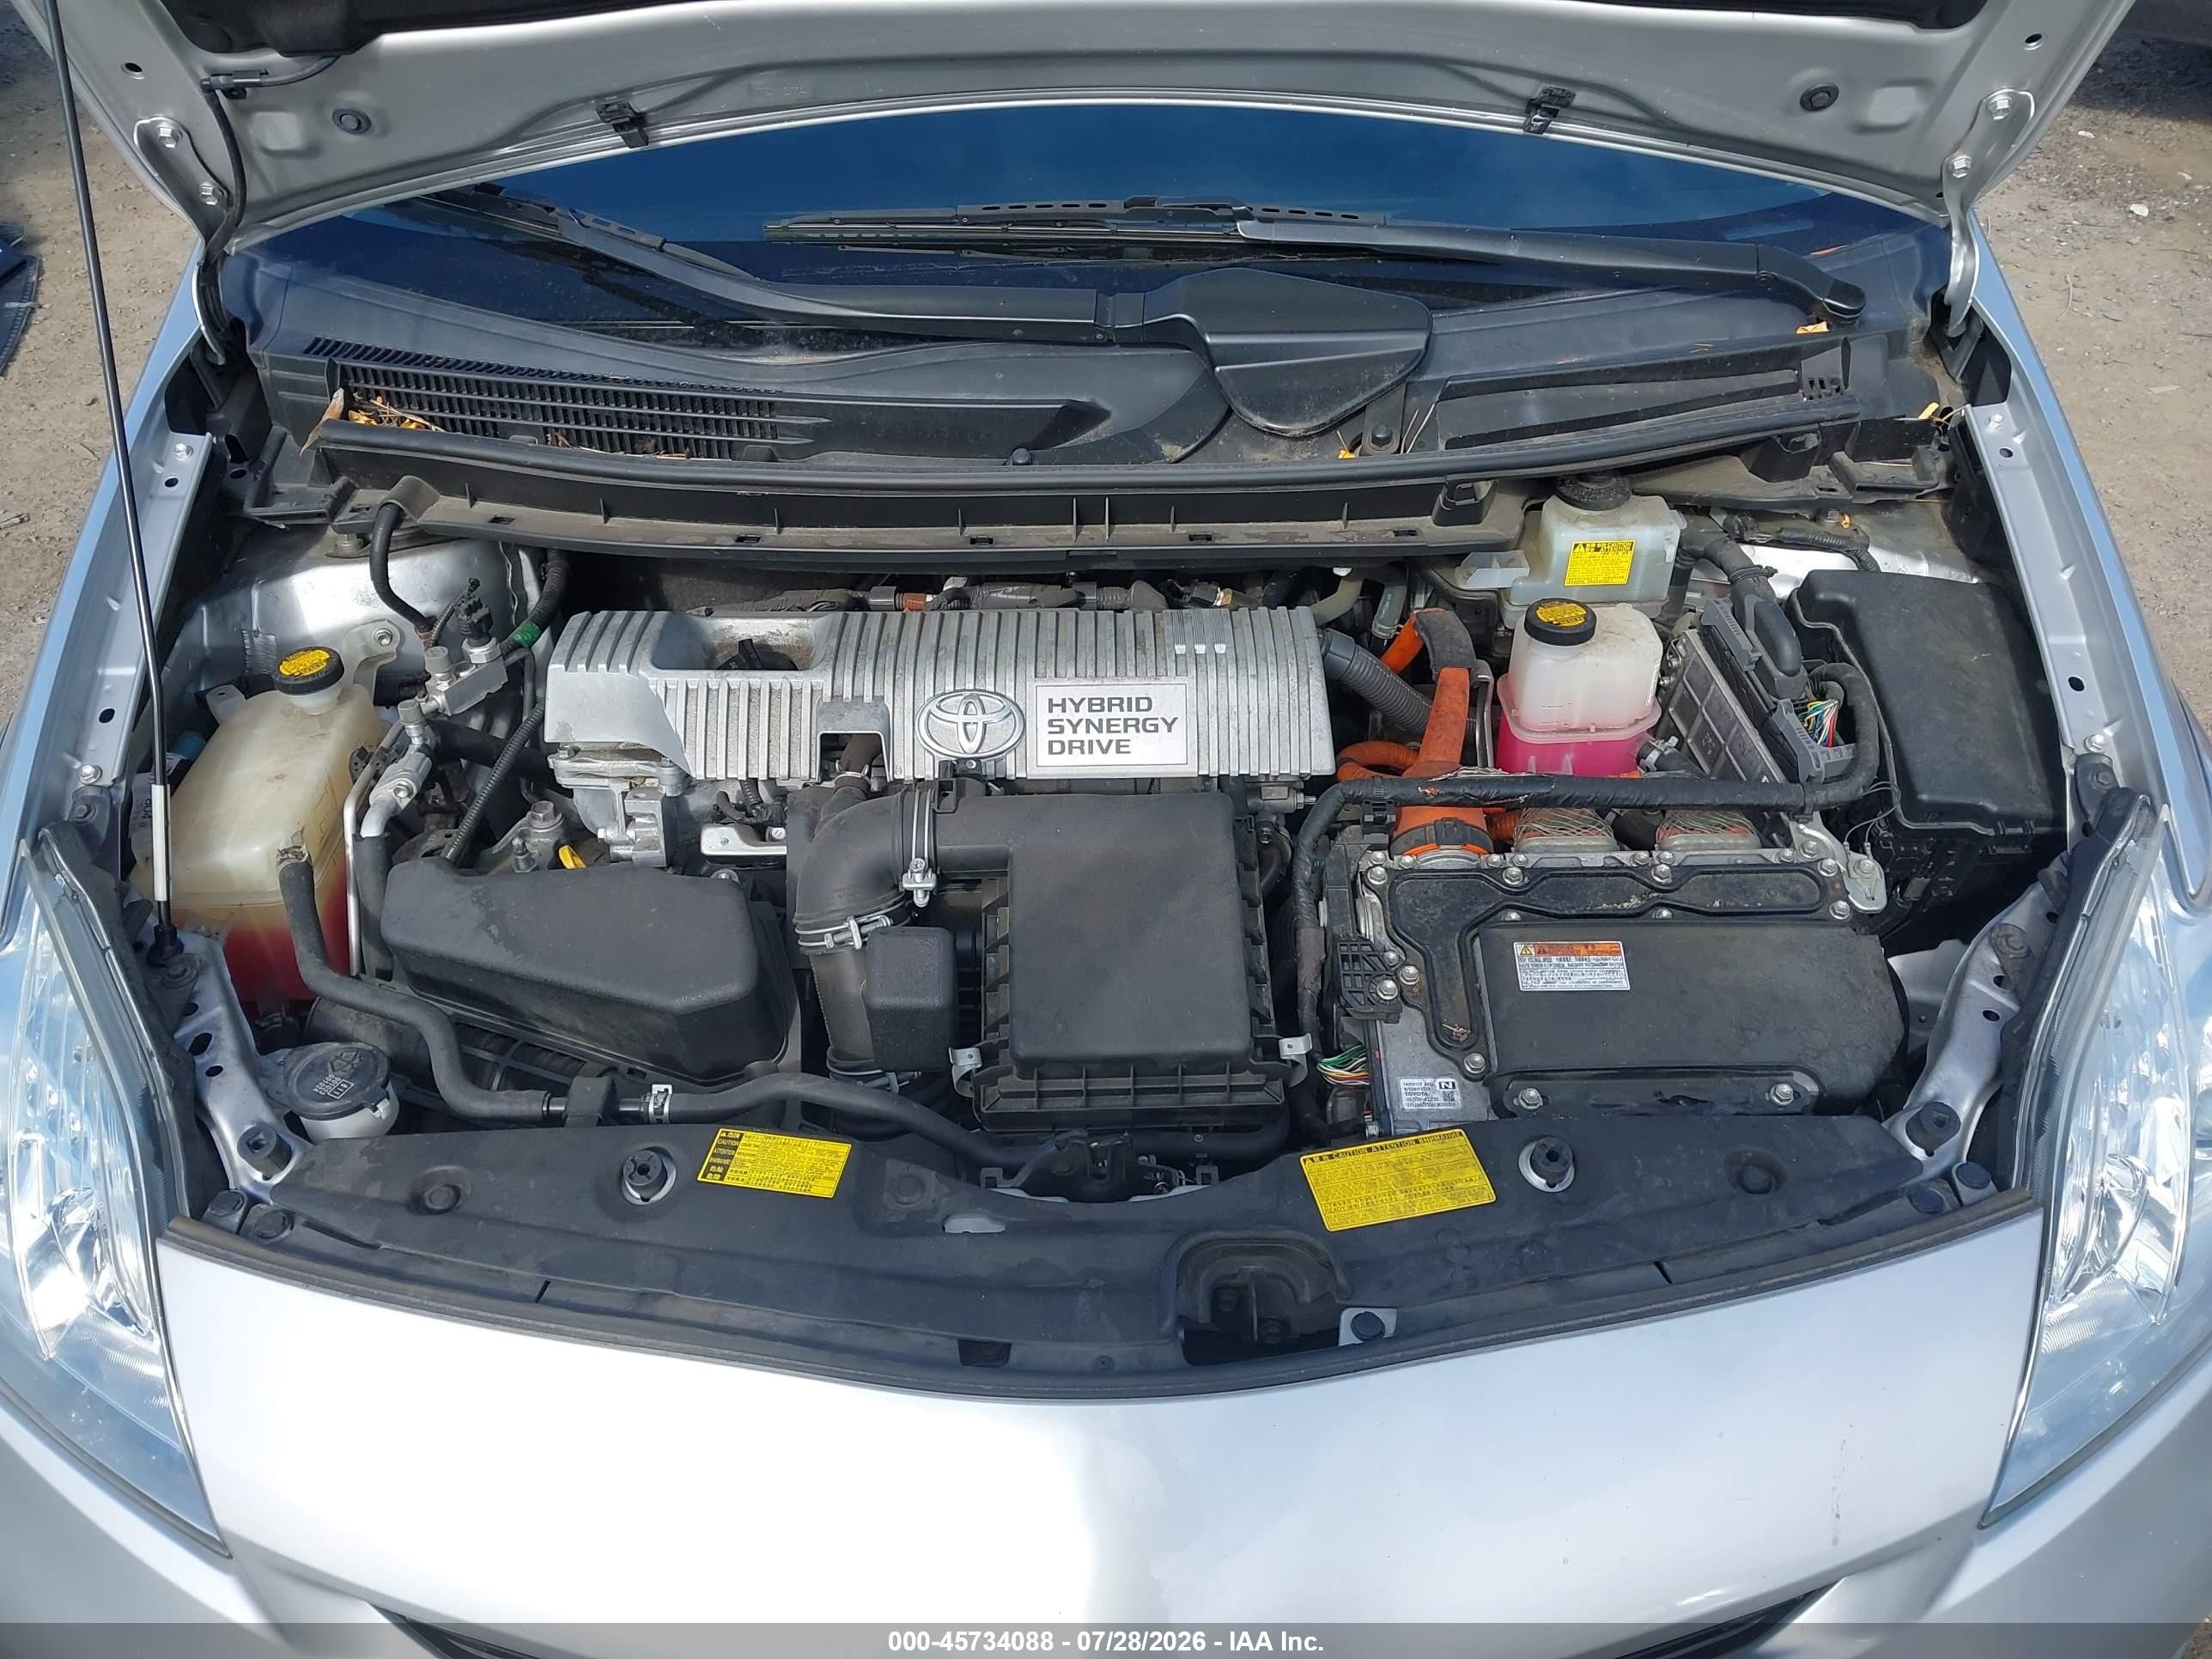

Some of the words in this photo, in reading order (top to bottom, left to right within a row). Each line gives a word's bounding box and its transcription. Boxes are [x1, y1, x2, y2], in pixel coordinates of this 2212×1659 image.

[1048, 696, 1153, 714] HYBRID
[1048, 716, 1179, 735] SYNERGY
[1048, 738, 1132, 756] DRIVE
[717, 1138, 739, 1147] CAUTION
[1333, 1147, 1368, 1160] CAUTION
[1371, 1139, 1416, 1153] ATTENTION
[1419, 1131, 1463, 1146] ВНИМАНИЕ
